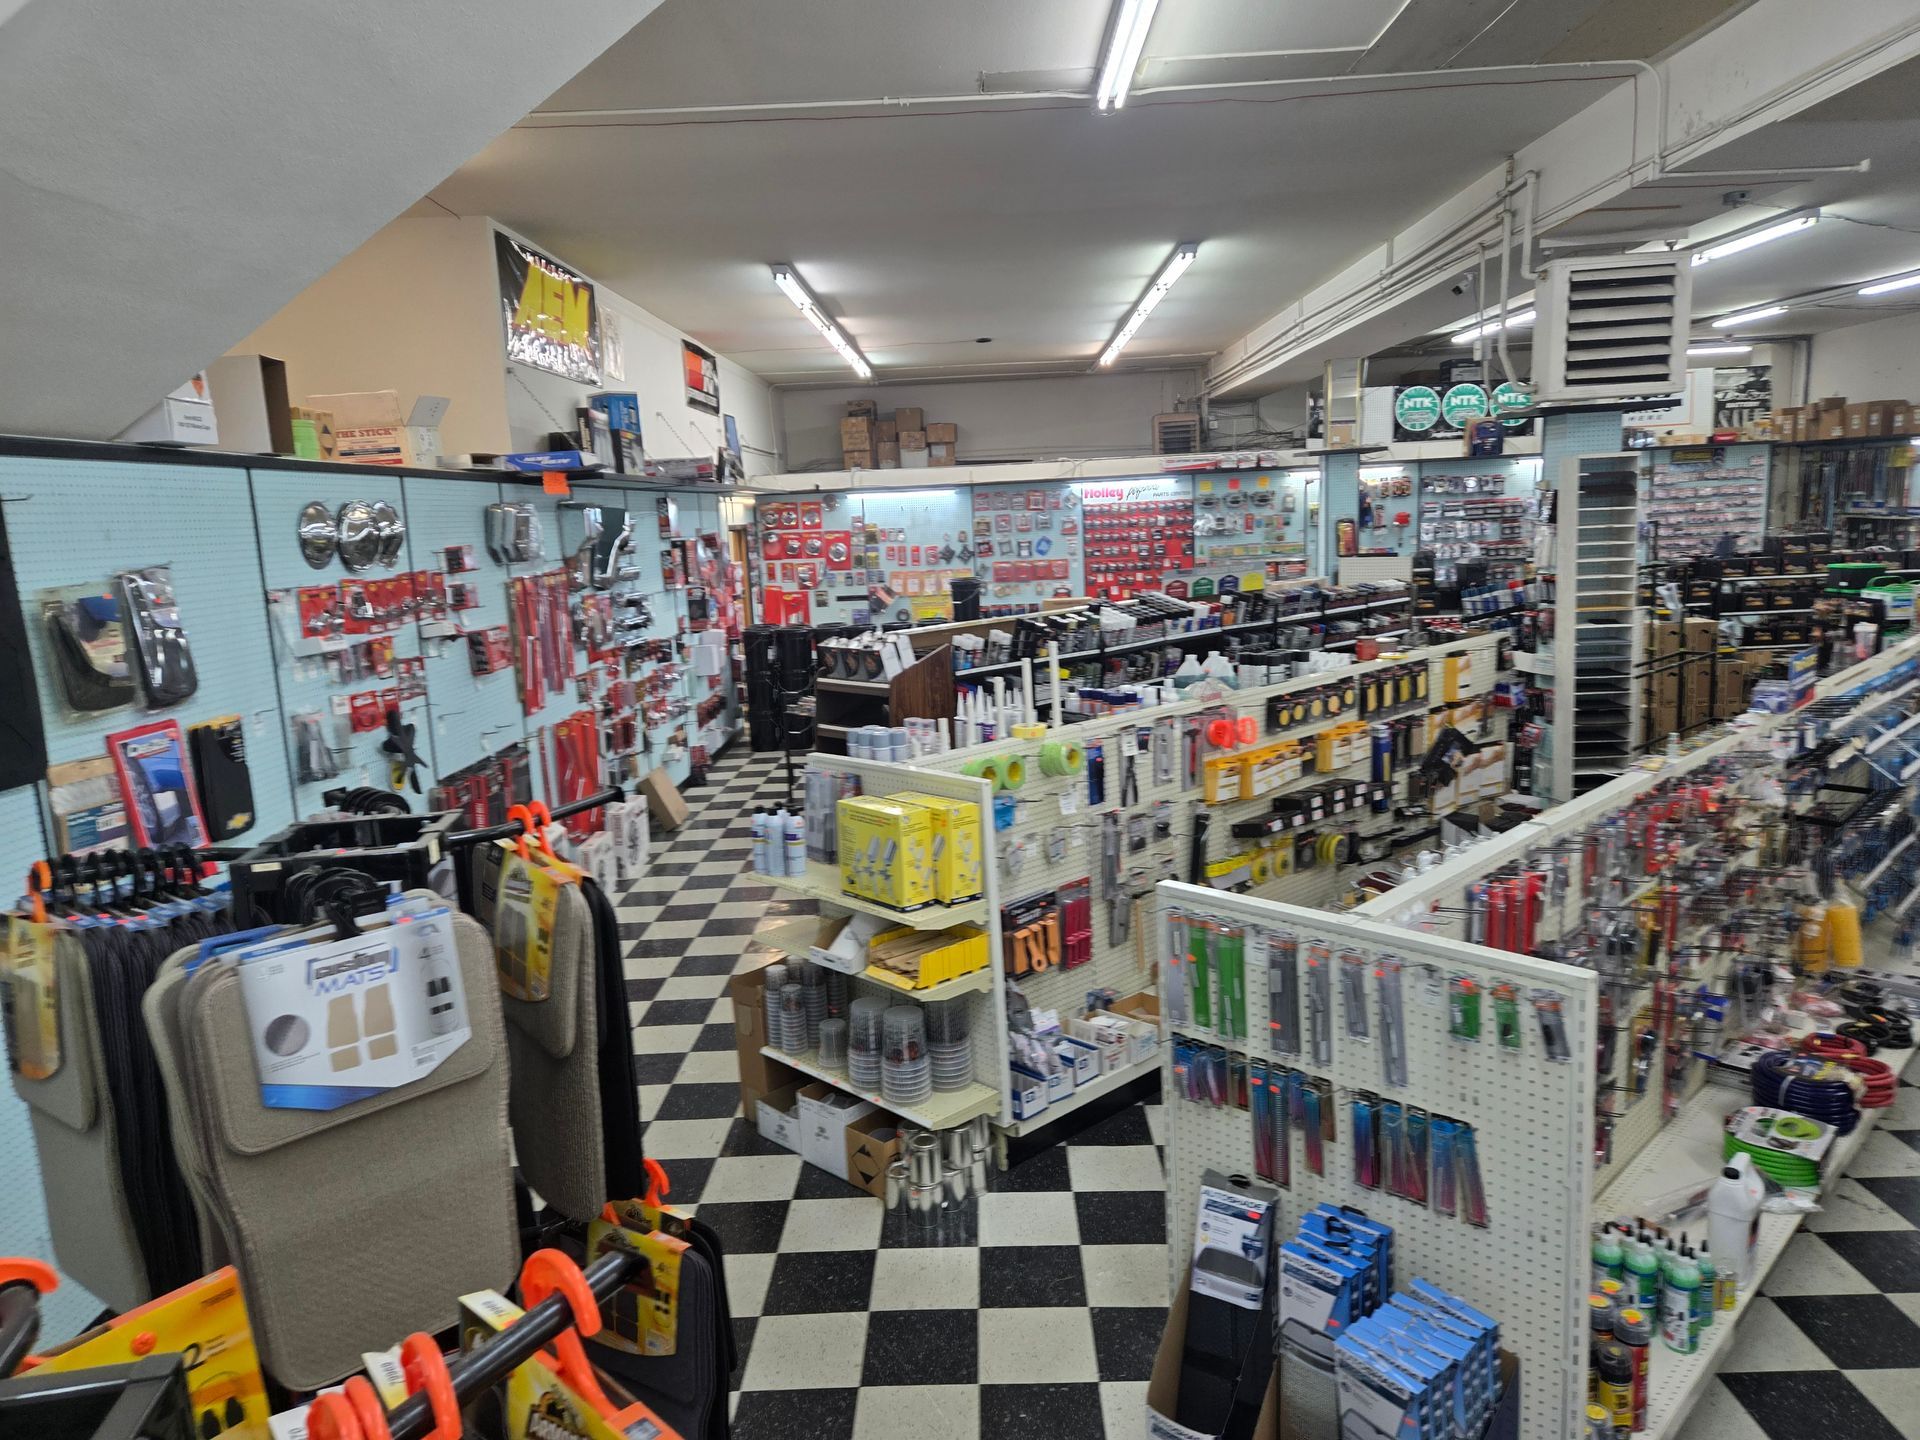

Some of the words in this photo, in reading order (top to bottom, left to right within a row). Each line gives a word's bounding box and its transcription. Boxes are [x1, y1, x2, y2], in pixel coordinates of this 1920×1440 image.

[514, 264, 590, 349] AEM
[1403, 397, 1432, 409] NTK
[1450, 394, 1478, 406] NTK
[1497, 392, 1527, 404] NTK
[336, 430, 356, 439] THE
[1084, 487, 1124, 501] Holley
[314, 963, 386, 997] MATS
[1200, 1188, 1265, 1212] AUTOSHADE
